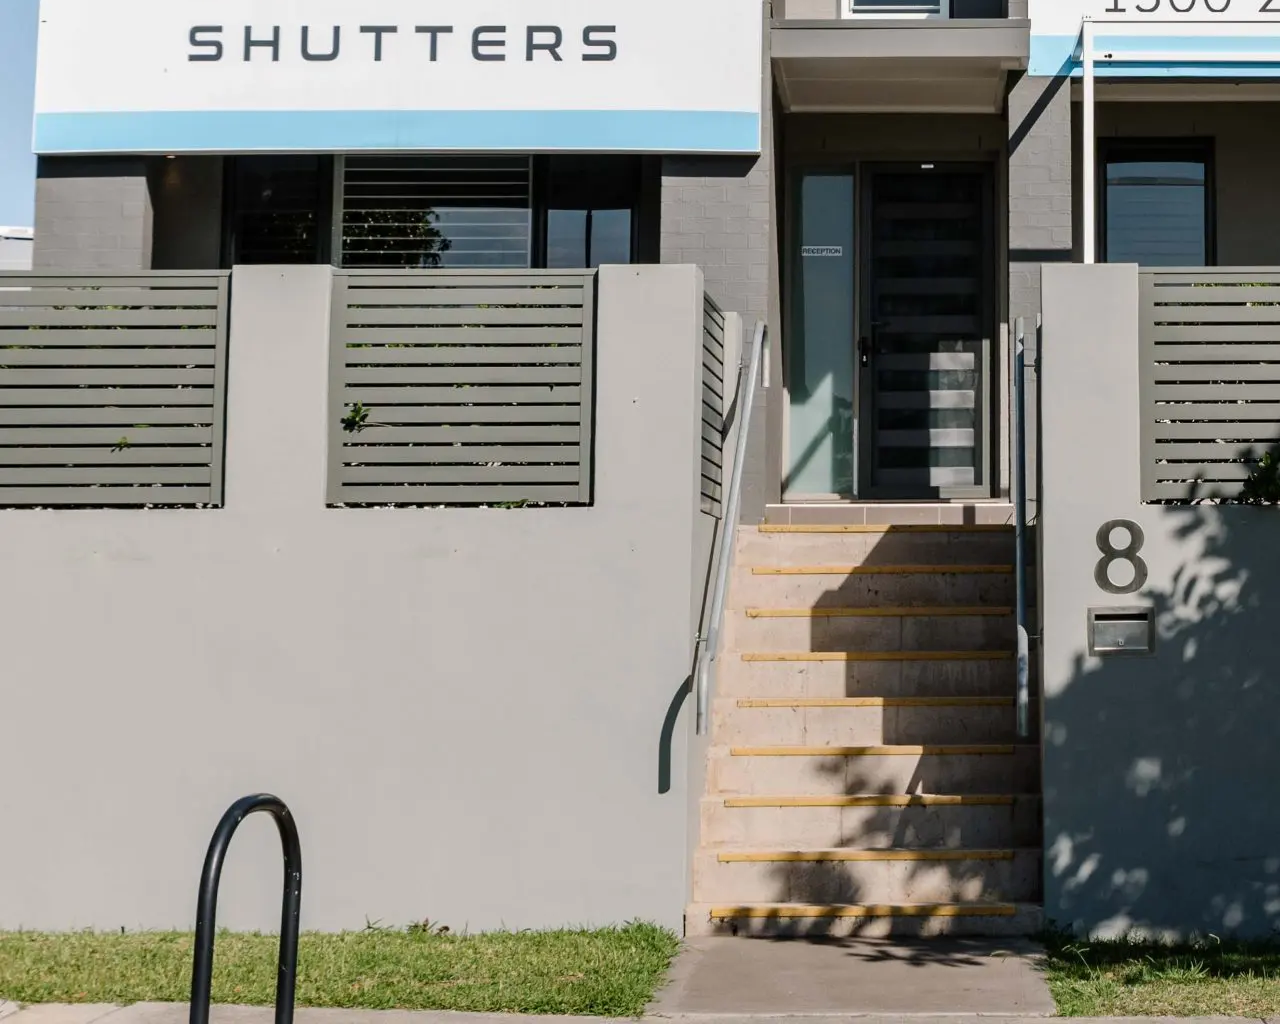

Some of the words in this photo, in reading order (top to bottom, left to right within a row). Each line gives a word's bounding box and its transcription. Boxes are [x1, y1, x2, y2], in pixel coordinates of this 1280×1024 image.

[187, 25, 618, 62] SHUTTERS
[802, 247, 841, 255] RECEPTION
[1094, 519, 1148, 594] 8
